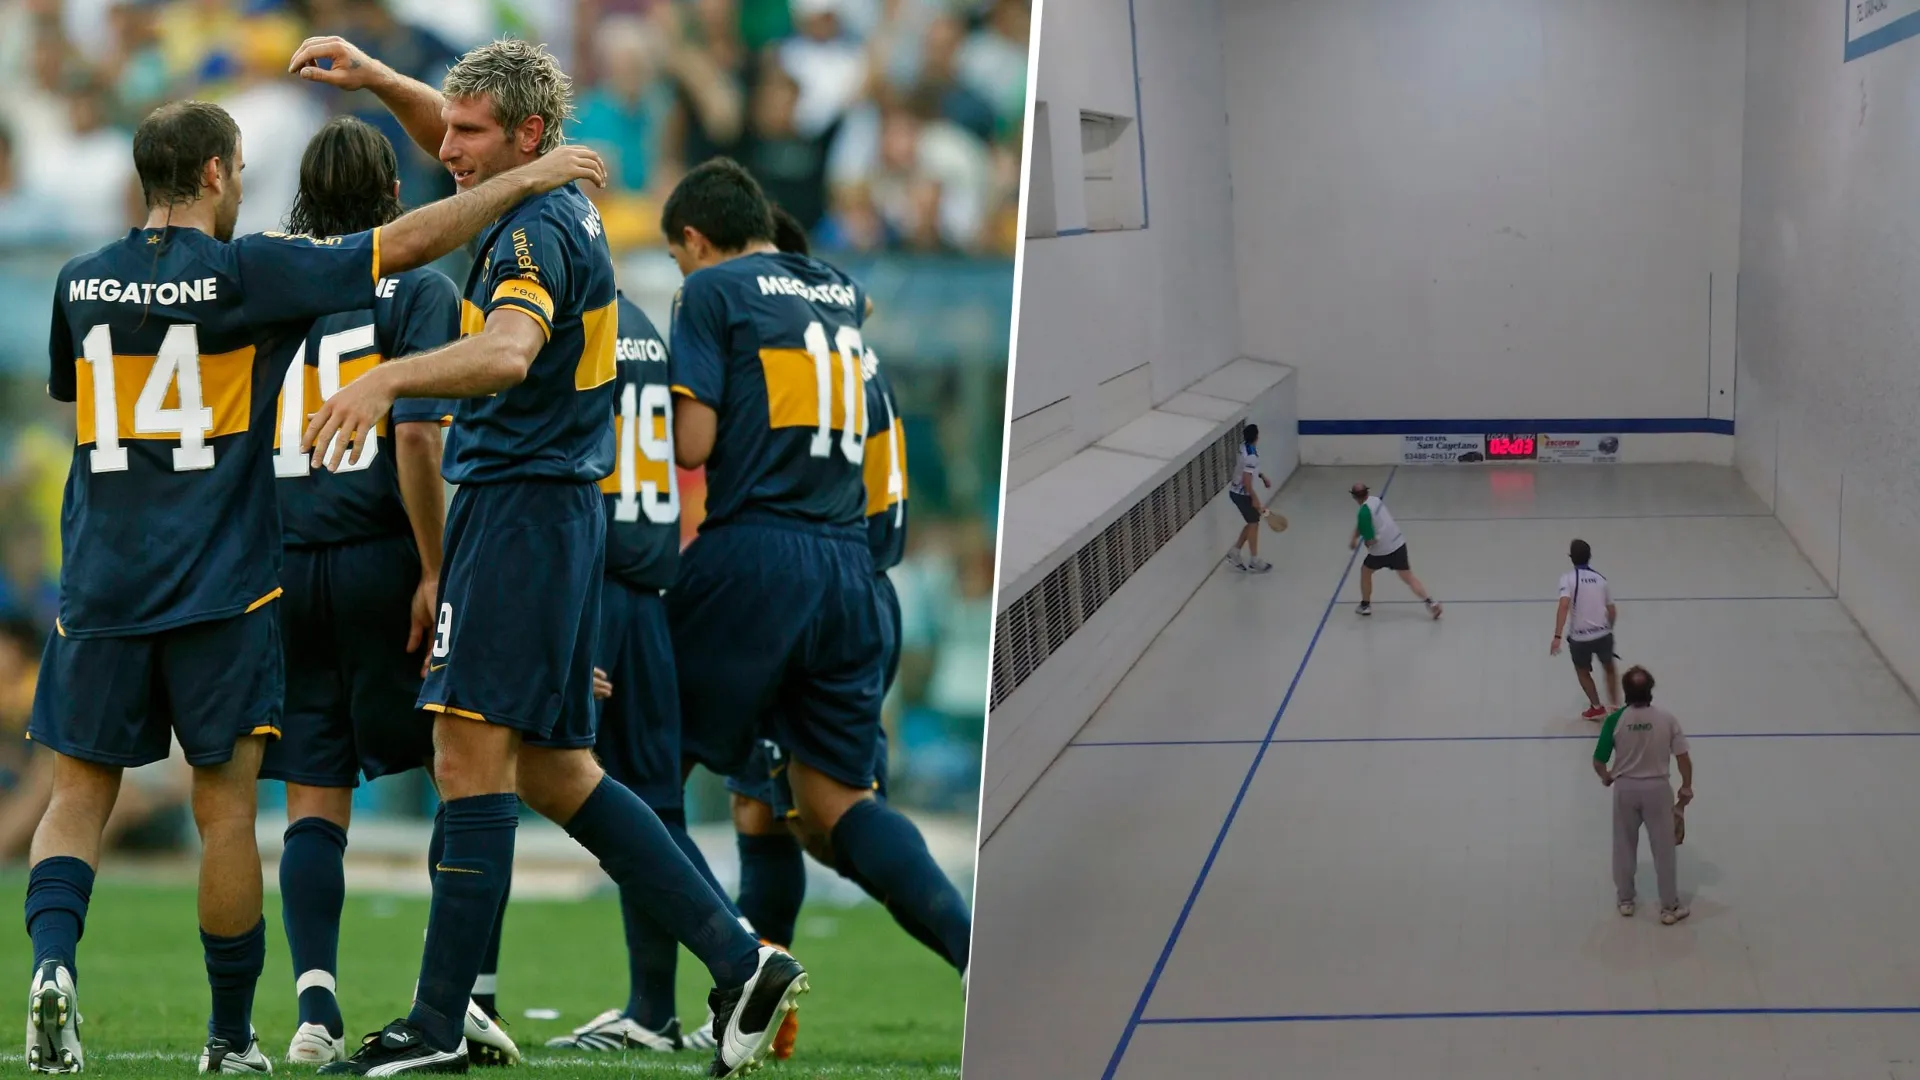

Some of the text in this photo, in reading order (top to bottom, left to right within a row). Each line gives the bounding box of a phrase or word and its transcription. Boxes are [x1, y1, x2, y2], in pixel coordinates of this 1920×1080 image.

[69, 277, 218, 305] MEGATONE
[512, 228, 540, 273] unicef
[82, 323, 215, 474] 14
[273, 323, 379, 479] 15
[614, 382, 681, 524] 19
[803, 321, 870, 466] 10
[433, 602, 453, 658] 9
